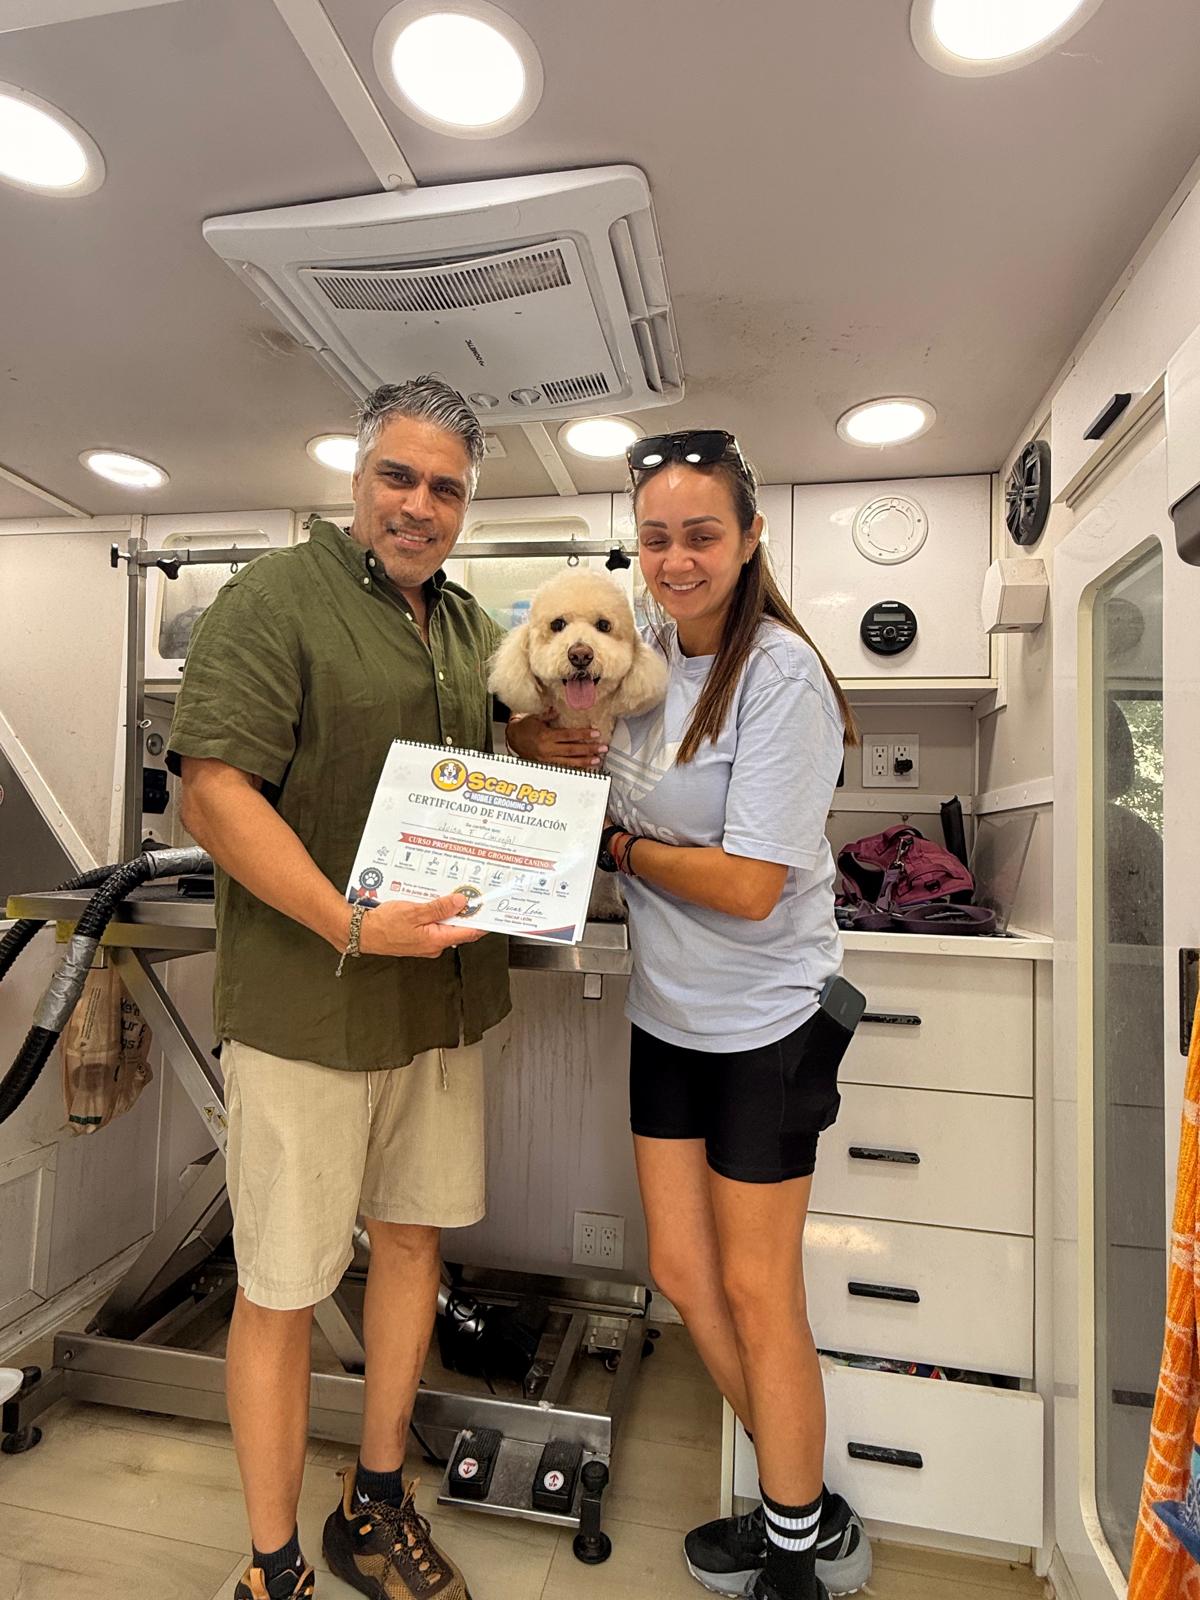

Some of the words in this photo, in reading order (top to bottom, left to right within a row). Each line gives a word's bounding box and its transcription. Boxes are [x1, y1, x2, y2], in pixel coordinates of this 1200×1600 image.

[465, 339, 482, 361] DOMETIC
[494, 796, 526, 810] GROOMING
[517, 781, 557, 806] Pets
[408, 792, 479, 815] CERTIFICADO
[480, 806, 495, 818] DE
[497, 809, 568, 832] FINALIZACIÓN
[408, 836, 431, 846] CURSO
[432, 838, 476, 855] PROFESIONAL
[487, 852, 523, 864] GROOMING
[524, 858, 549, 868] CANINO
